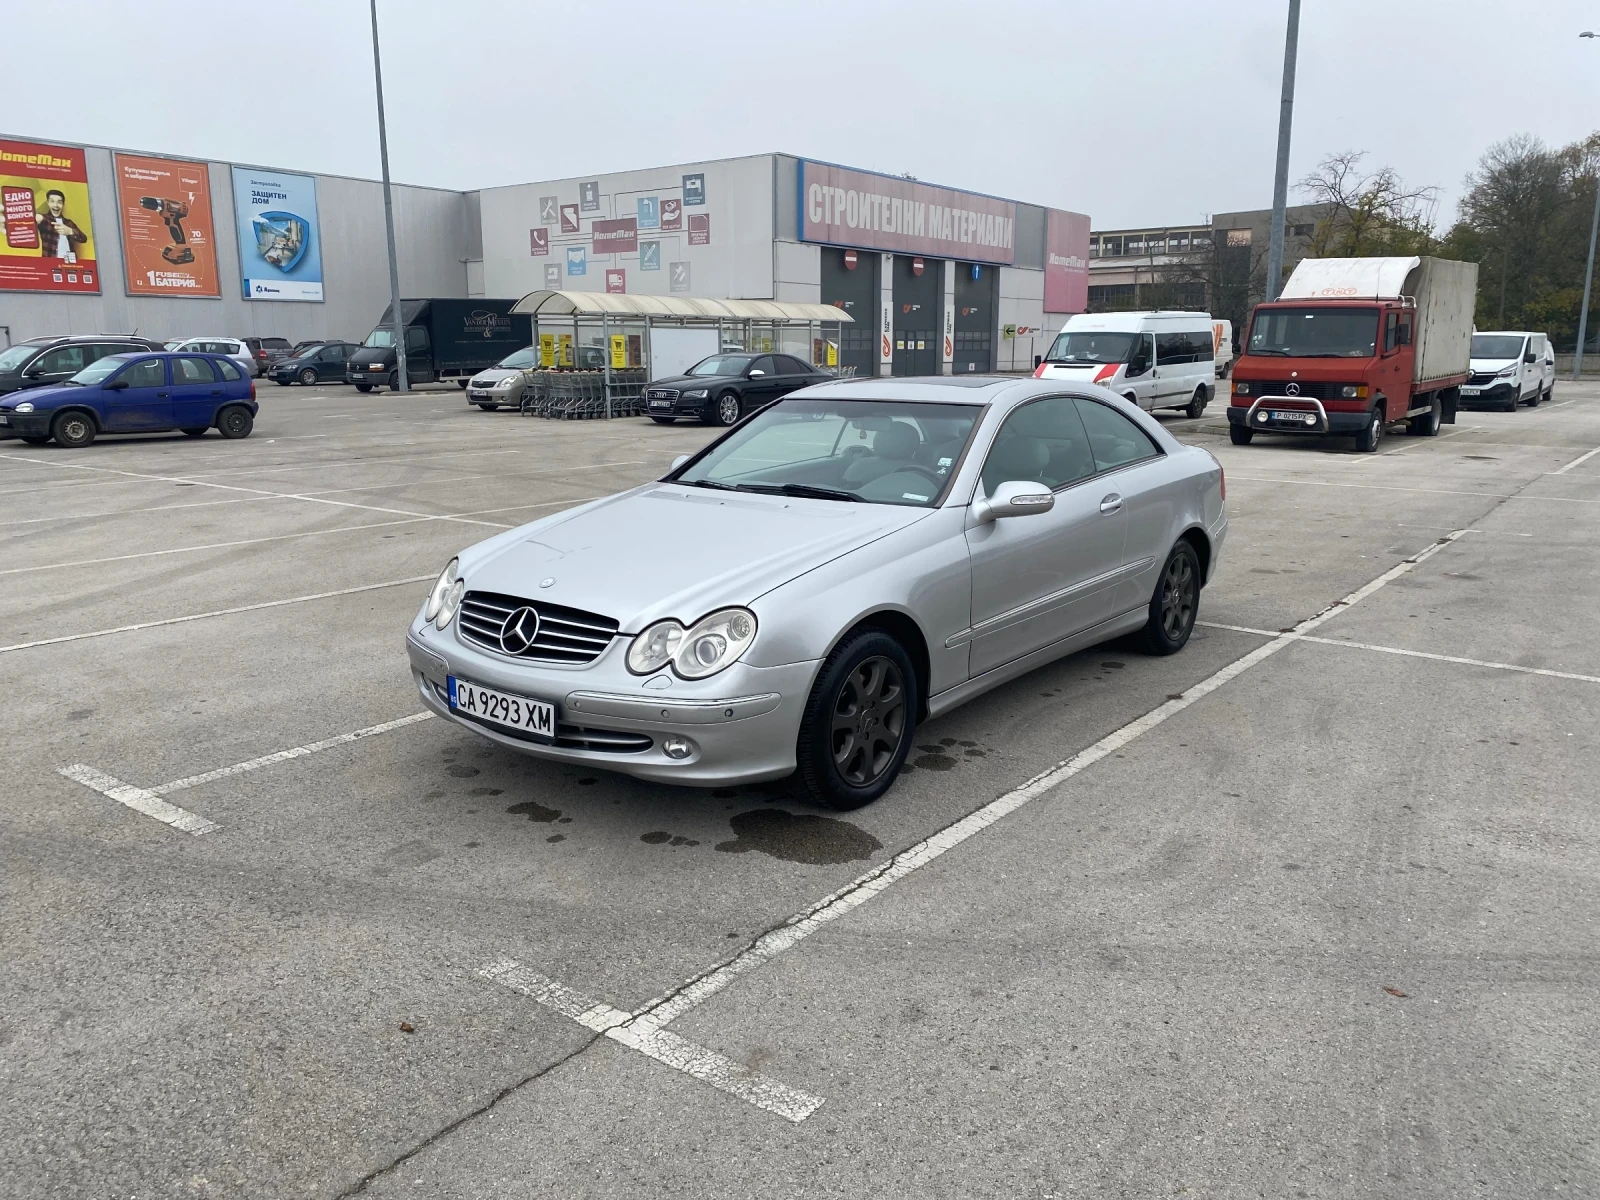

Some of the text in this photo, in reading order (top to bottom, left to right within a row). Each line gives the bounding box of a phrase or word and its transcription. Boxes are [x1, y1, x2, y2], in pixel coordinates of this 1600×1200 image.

[4, 191, 31, 202] ЕДНО
[251, 190, 287, 200] ЗАЩИТЕН
[6, 205, 33, 213] МНОГО
[808, 183, 1013, 249] СТРОИТЕЛНИ МАТЕРИАЛИ
[593, 230, 635, 240] HomeMax
[1049, 253, 1086, 268] HomeMax
[156, 278, 196, 288] БАТЕРИЯ
[457, 683, 551, 733] CA 9293 XM
